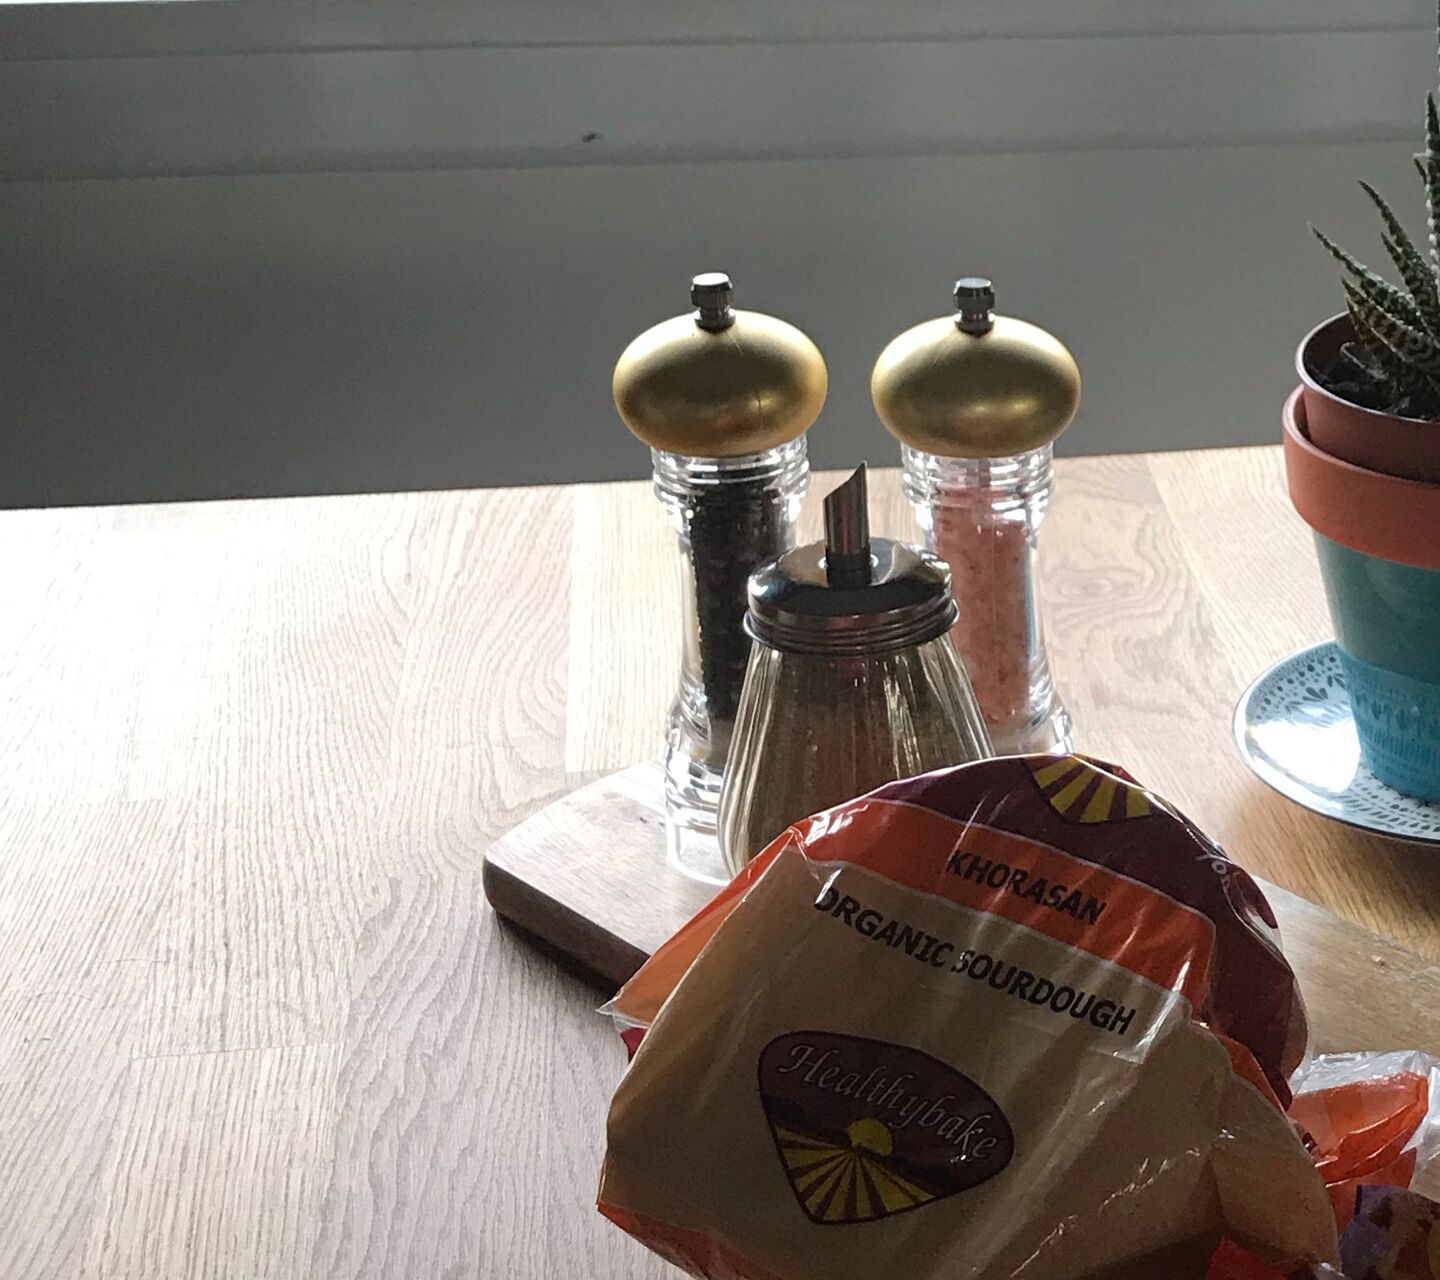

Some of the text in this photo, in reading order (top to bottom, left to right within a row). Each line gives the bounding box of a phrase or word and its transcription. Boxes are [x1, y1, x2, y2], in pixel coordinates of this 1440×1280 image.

[946, 849, 1107, 926] KHORASAN
[813, 884, 1137, 1036] ORGANIC SOURDOUGH
[778, 1044, 998, 1162] Healthybake
